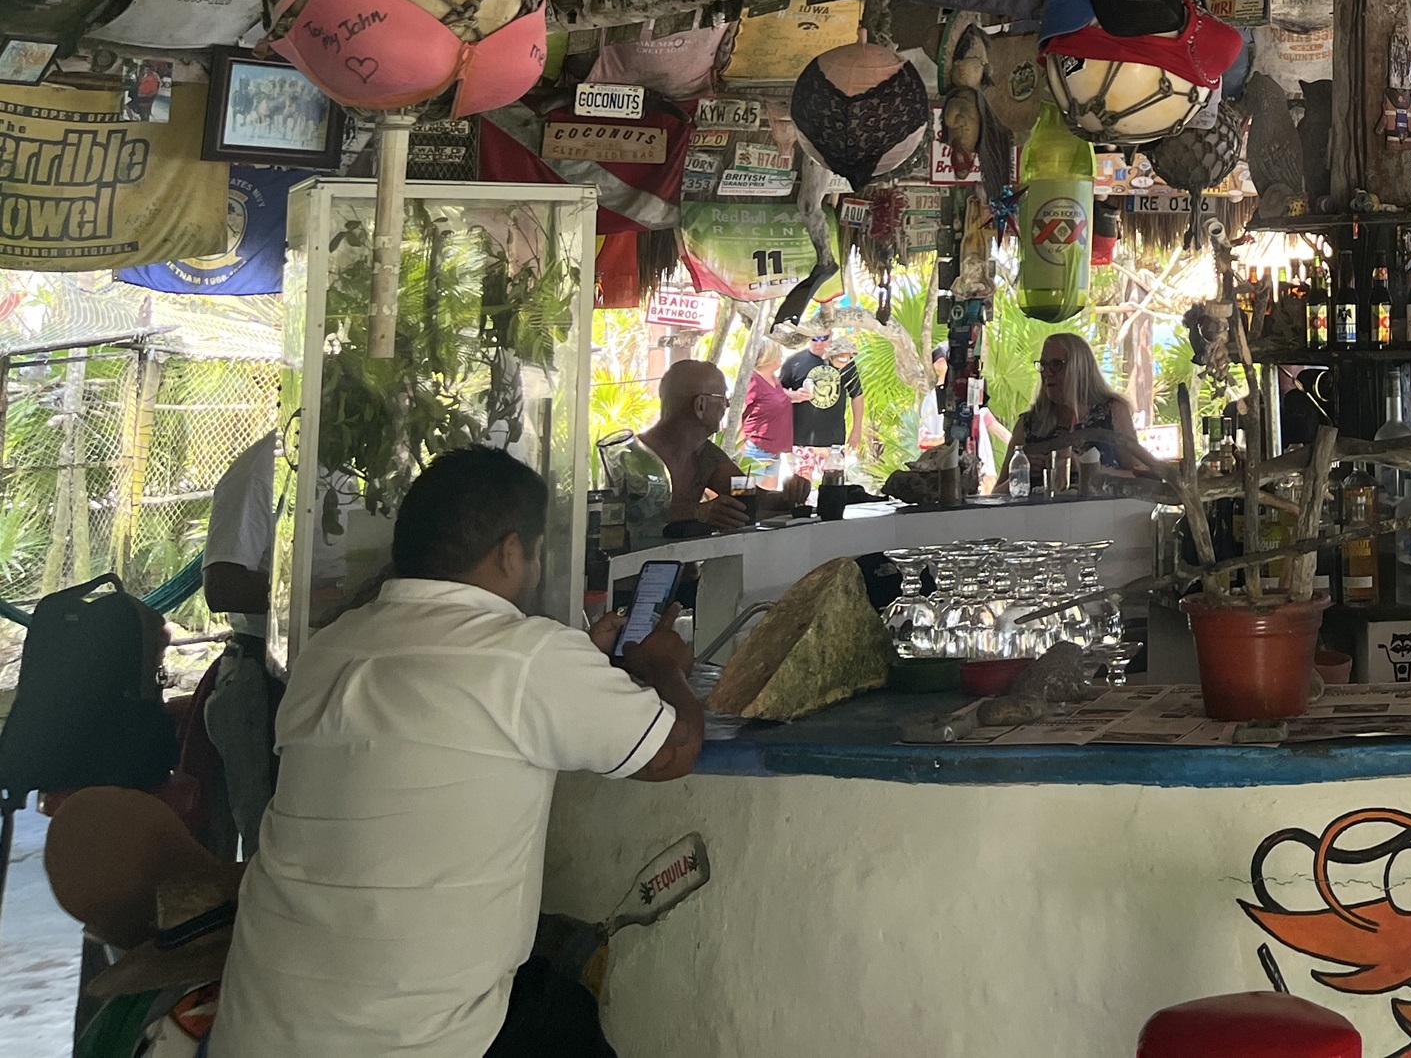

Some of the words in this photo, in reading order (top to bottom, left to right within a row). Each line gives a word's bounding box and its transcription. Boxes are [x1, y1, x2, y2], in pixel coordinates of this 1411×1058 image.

[799, 4, 830, 17] IOWA
[338, 10, 388, 42] John
[32, 108, 82, 121] COPE'S
[700, 104, 727, 123] KYW
[733, 106, 759, 123] 645
[554, 126, 657, 146] COCONUTS
[552, 145, 589, 158] CLIFF
[596, 150, 625, 160] SIDE
[632, 150, 656, 159] BAR
[724, 173, 767, 182] BRITISH
[1139, 197, 1160, 211] RE
[712, 208, 737, 224] Red
[740, 209, 767, 225] Bull
[1043, 210, 1060, 218] DOS
[752, 249, 784, 277] 11
[748, 277, 800, 291] CHECO
[648, 855, 695, 897] TEQUILA
